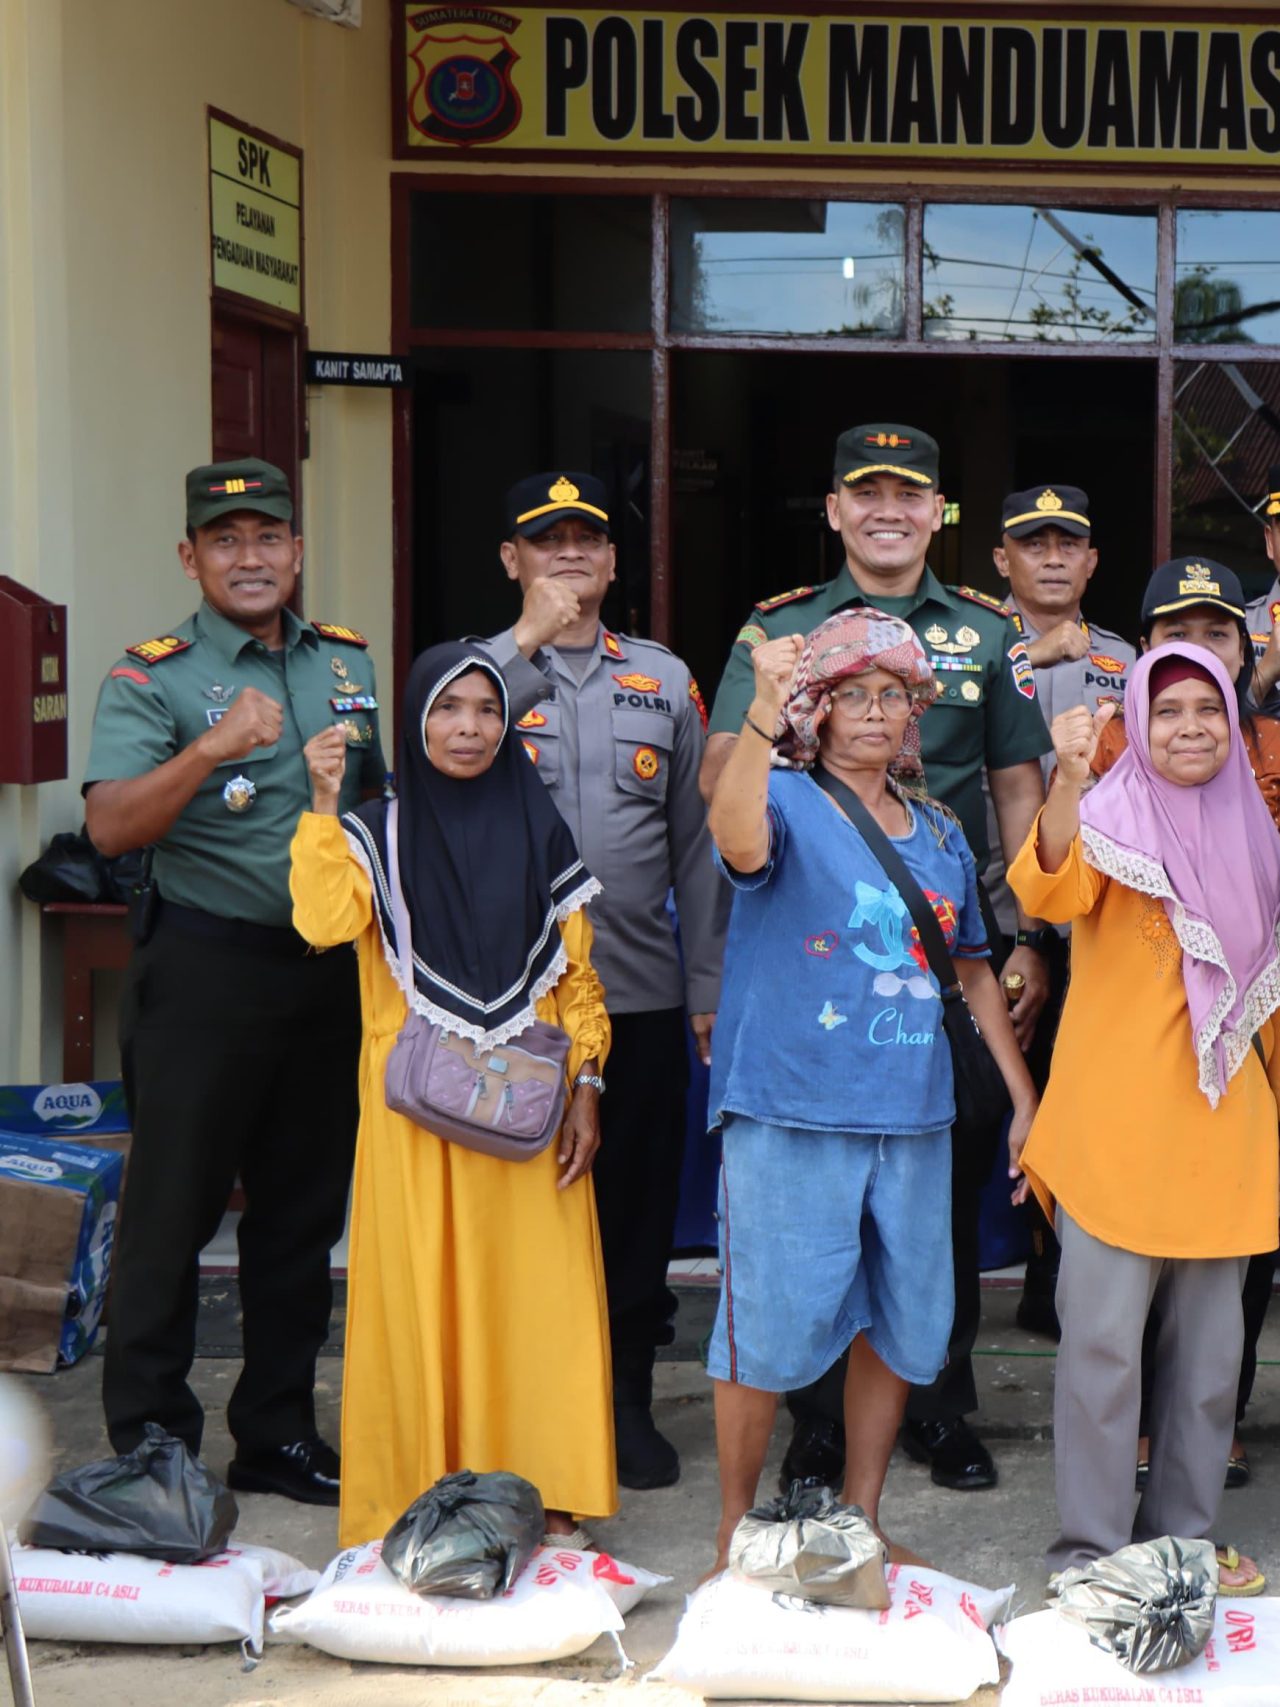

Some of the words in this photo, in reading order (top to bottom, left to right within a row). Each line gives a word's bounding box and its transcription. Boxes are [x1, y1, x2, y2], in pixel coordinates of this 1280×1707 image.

[545, 15, 810, 142] POLSEK
[238, 137, 271, 187] SPK
[236, 202, 275, 237] PELAYANAN
[213, 234, 254, 271] PENGADUAN
[256, 250, 298, 286] MASYARAKAT
[316, 360, 349, 378] KANIT
[353, 361, 402, 381] SAMAPTA
[41, 656, 59, 684] KOTAK
[33, 693, 67, 723] SARAN
[612, 693, 672, 713] POLRI
[43, 1094, 92, 1110] AQUA
[18, 1578, 92, 1595] KUKUBALAM
[95, 1583, 110, 1597] C4
[111, 1586, 141, 1600] ASLI
[1083, 1687, 1156, 1702] KUKUBALAM
